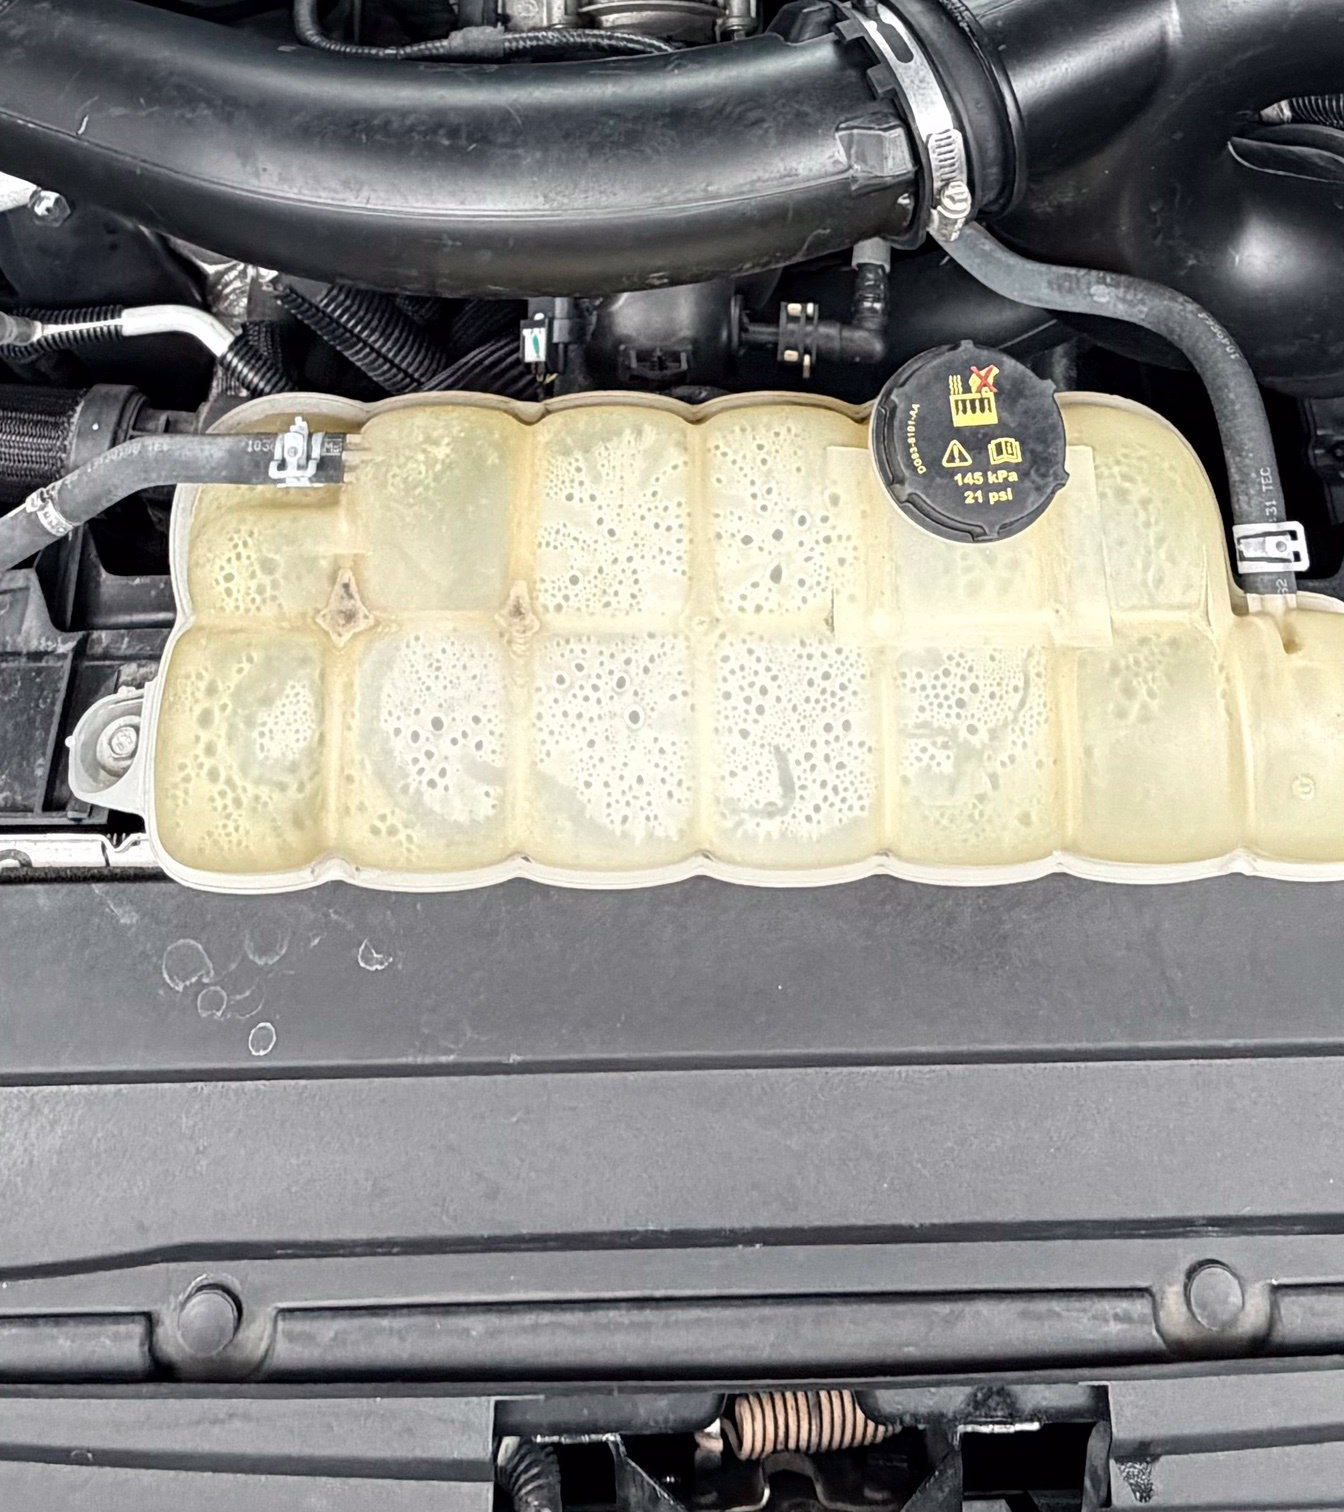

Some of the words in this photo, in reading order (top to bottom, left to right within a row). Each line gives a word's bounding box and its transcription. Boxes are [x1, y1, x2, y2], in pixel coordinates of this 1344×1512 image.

[954, 471, 983, 487] 145
[987, 469, 1019, 484] kPa
[1259, 466, 1274, 491] TEC
[964, 490, 983, 505] 21
[988, 487, 1013, 505] psi
